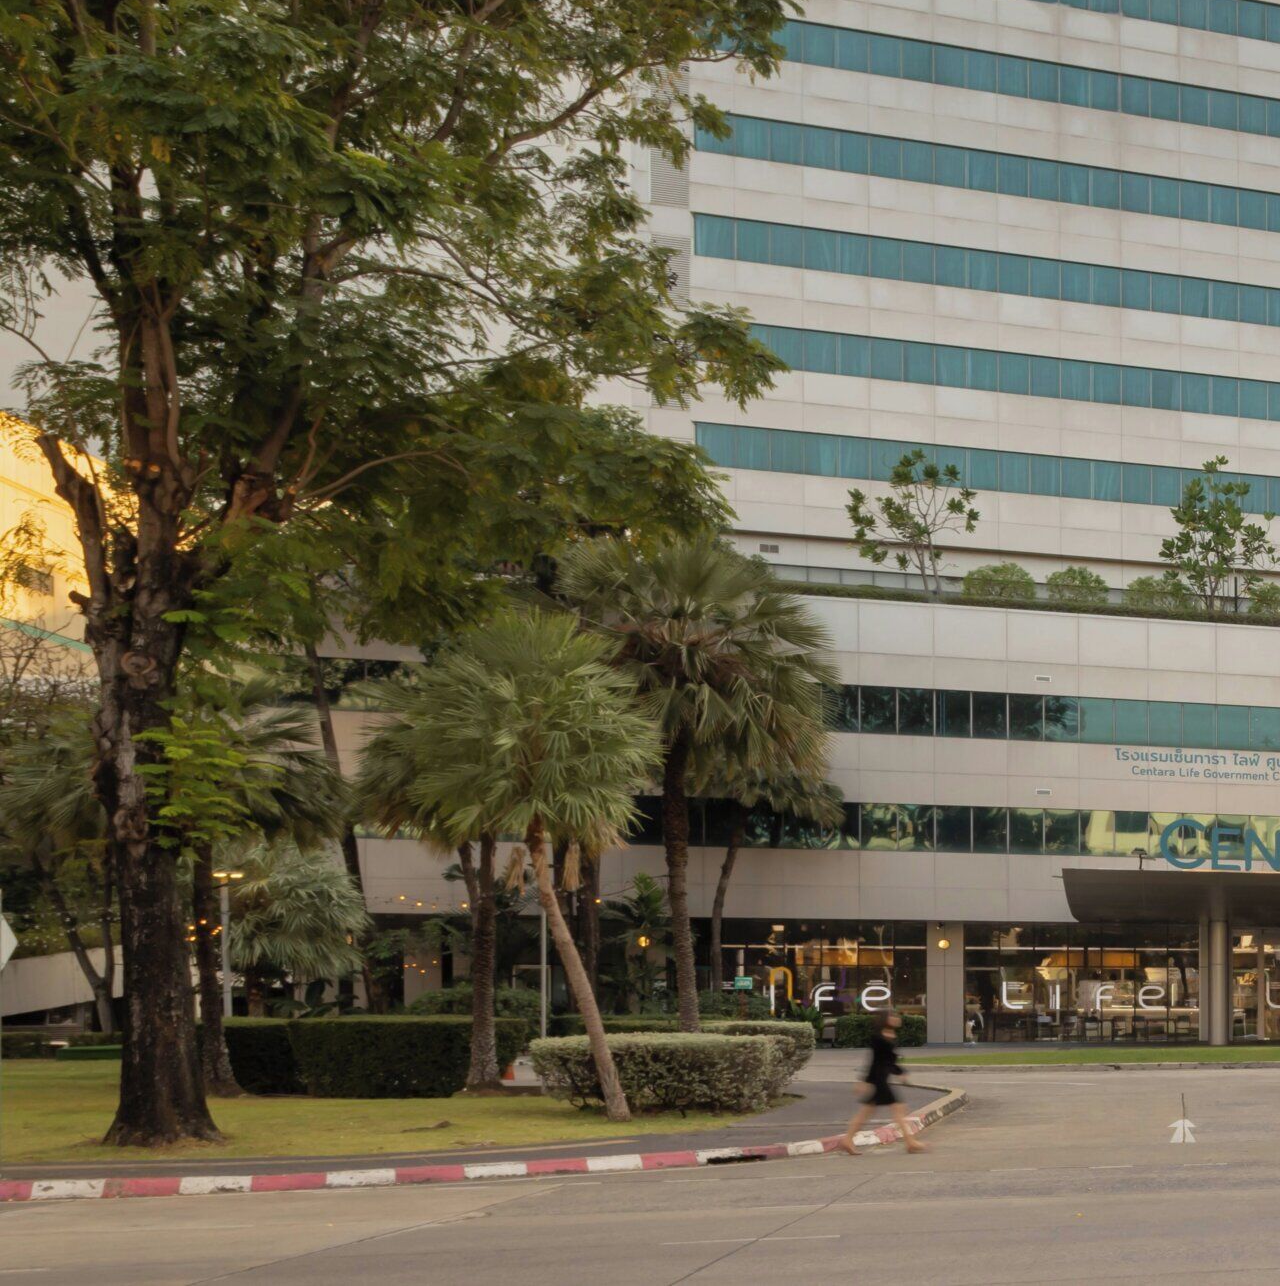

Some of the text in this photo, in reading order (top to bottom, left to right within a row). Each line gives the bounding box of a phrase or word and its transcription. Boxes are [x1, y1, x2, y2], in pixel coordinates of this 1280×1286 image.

[1114, 747, 1226, 765] โรงแรมเซ็นทารา
[1233, 752, 1260, 767] ไลฟ์
[1131, 765, 1176, 777] Centara
[1179, 766, 1200, 778] Life
[1203, 768, 1269, 781] Government
